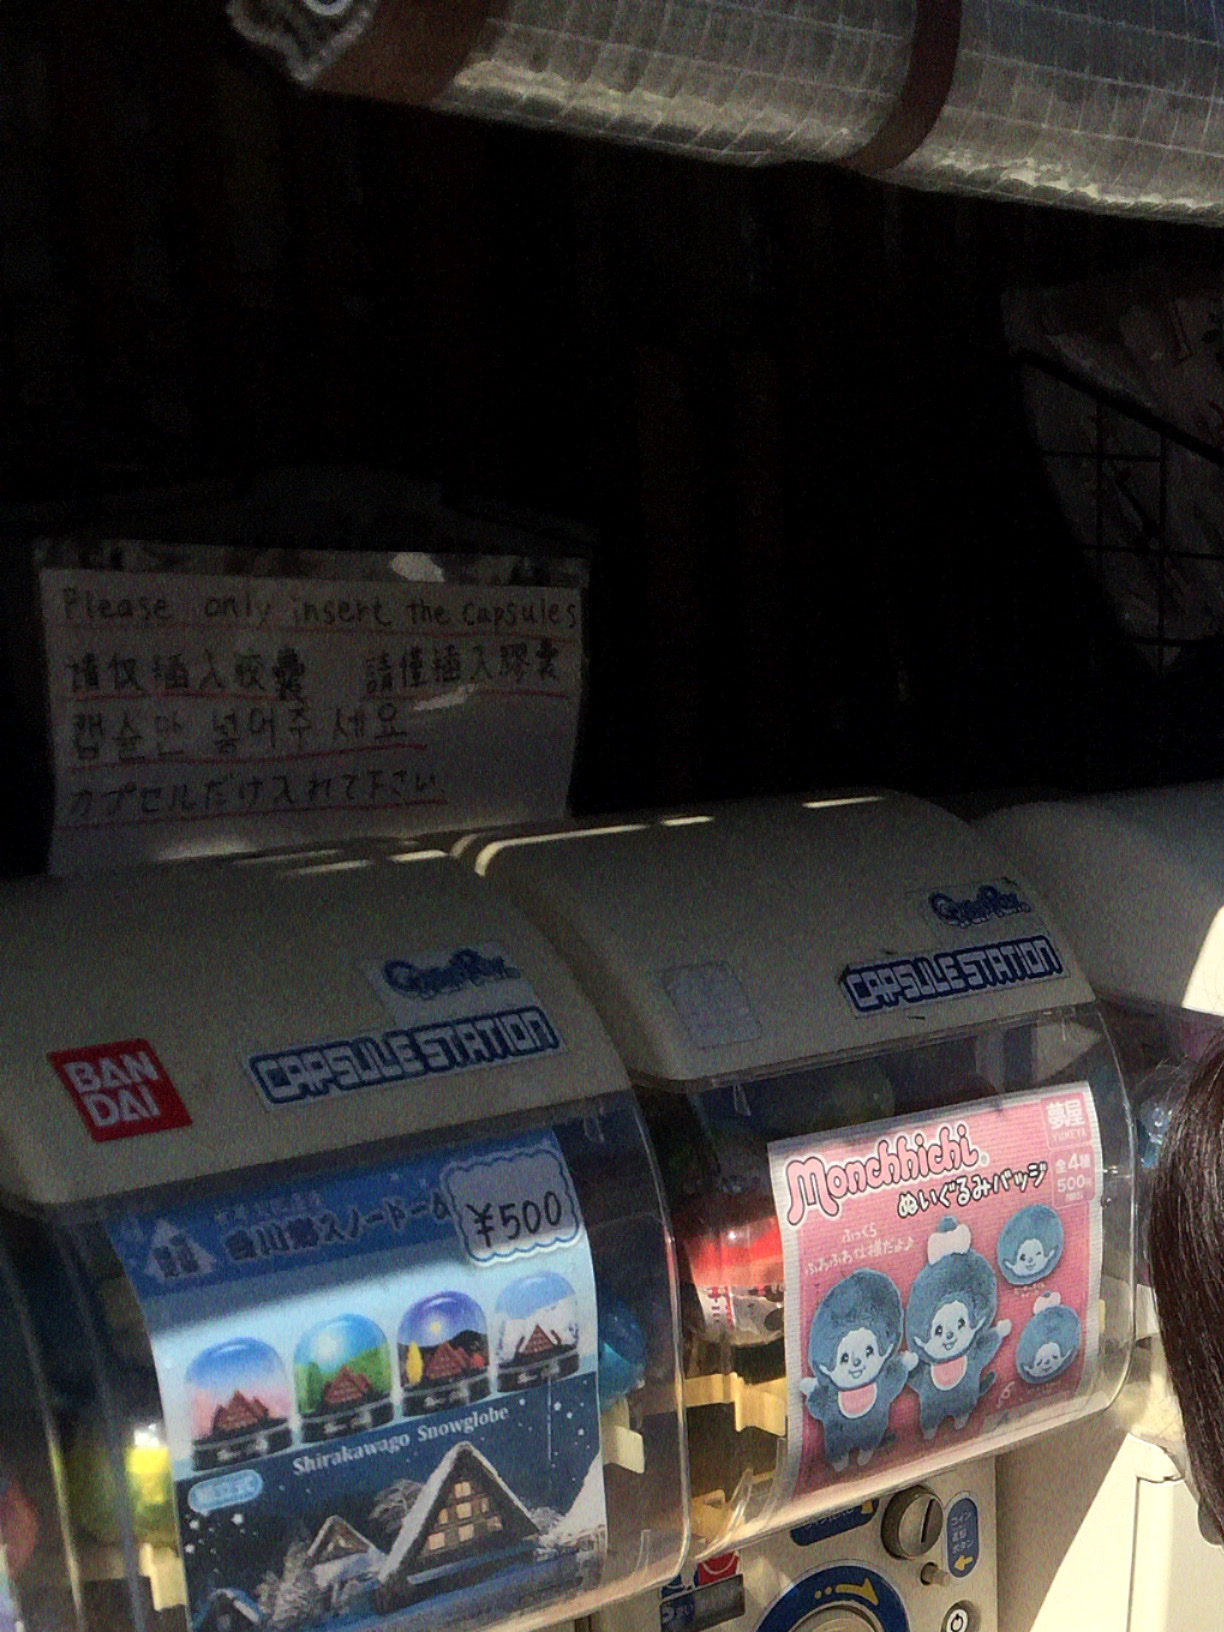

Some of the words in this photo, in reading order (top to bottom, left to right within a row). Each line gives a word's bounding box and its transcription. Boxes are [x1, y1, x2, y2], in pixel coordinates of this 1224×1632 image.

[63, 586, 172, 620] Please
[205, 592, 270, 629] only
[291, 592, 391, 626] insert
[406, 598, 451, 625] the
[463, 597, 576, 631] capsules
[62, 1049, 160, 1095] BAN
[82, 1087, 161, 1126] DAI
[787, 1124, 979, 1226] Monchhichi
[897, 1161, 1048, 1218] ぬいぐるみバッジ
[466, 1190, 562, 1248] ¥500
[293, 1431, 411, 1476] Shirakawago
[416, 1406, 509, 1443] Snowglobe
